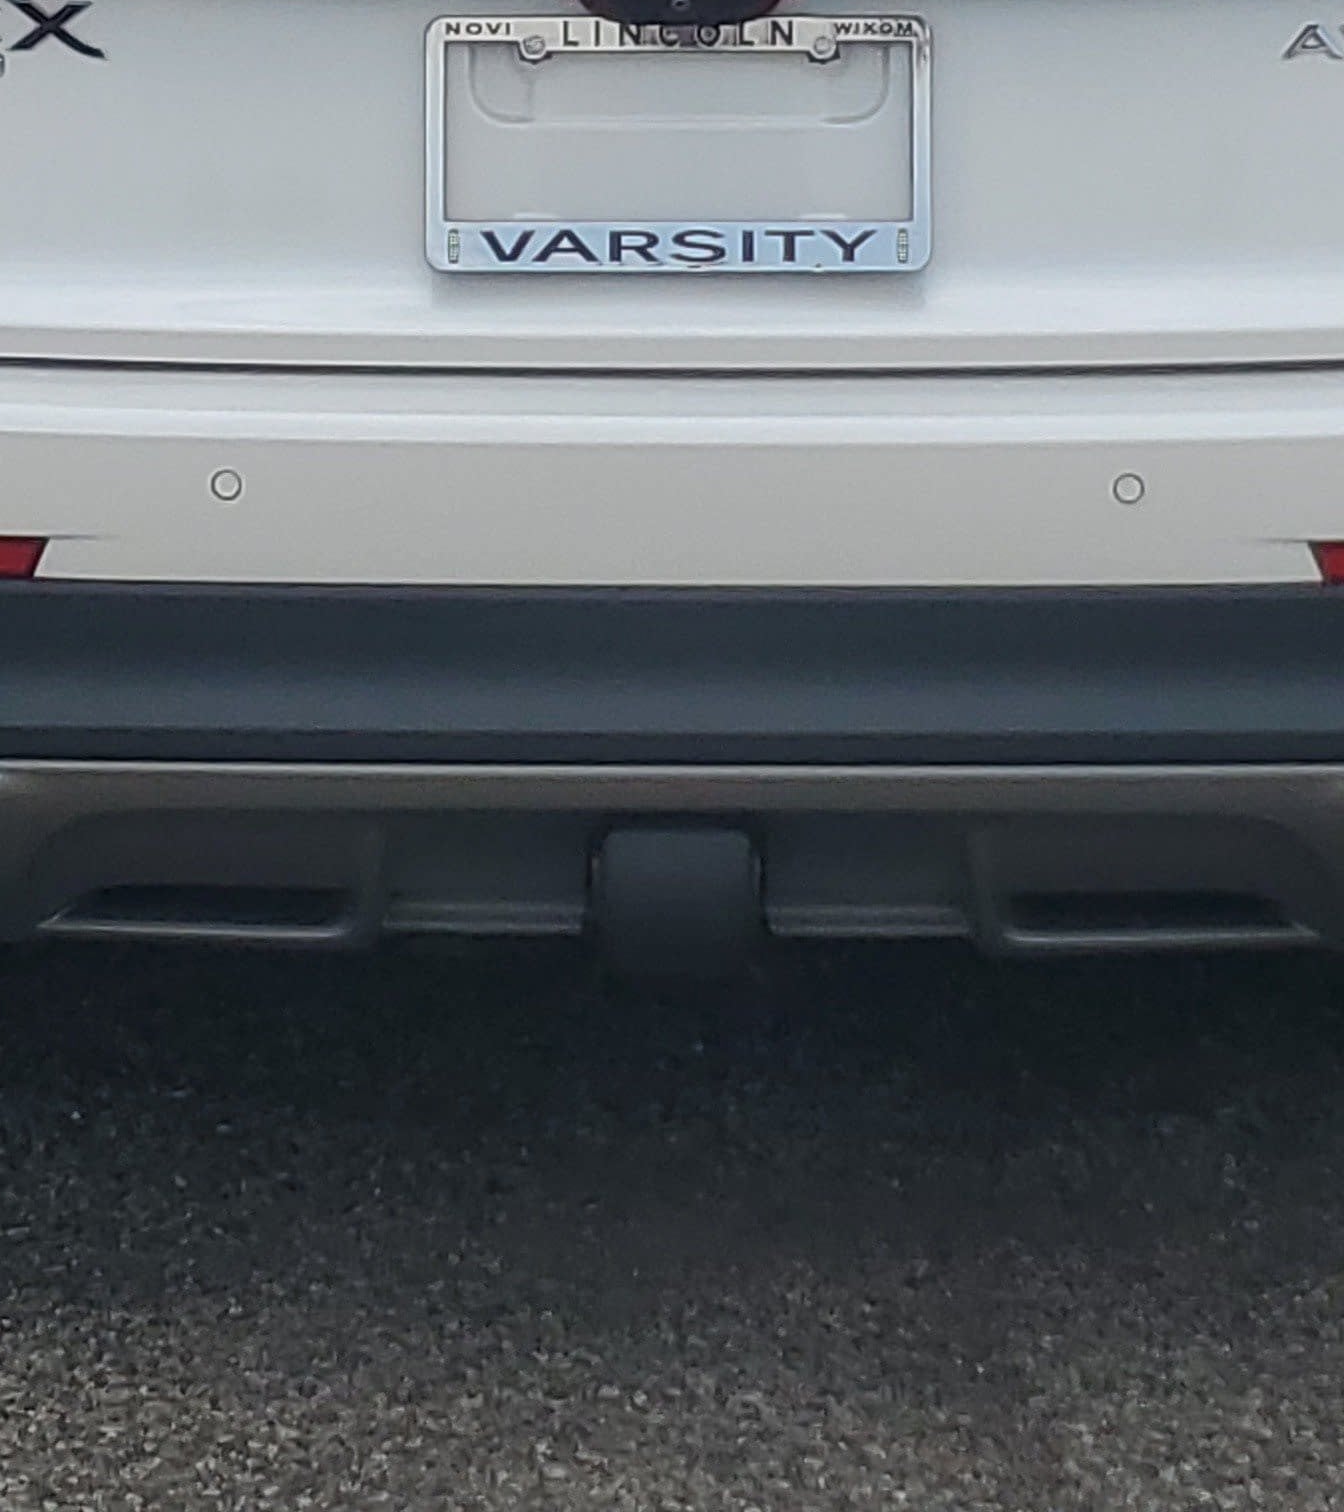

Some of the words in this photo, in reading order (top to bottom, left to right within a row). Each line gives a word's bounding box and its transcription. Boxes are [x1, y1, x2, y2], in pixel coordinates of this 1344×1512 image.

[444, 21, 511, 36] NOVI
[562, 20, 795, 47] LINCOLN
[833, 21, 914, 38] WIXOM
[480, 228, 878, 265] VARSITY
